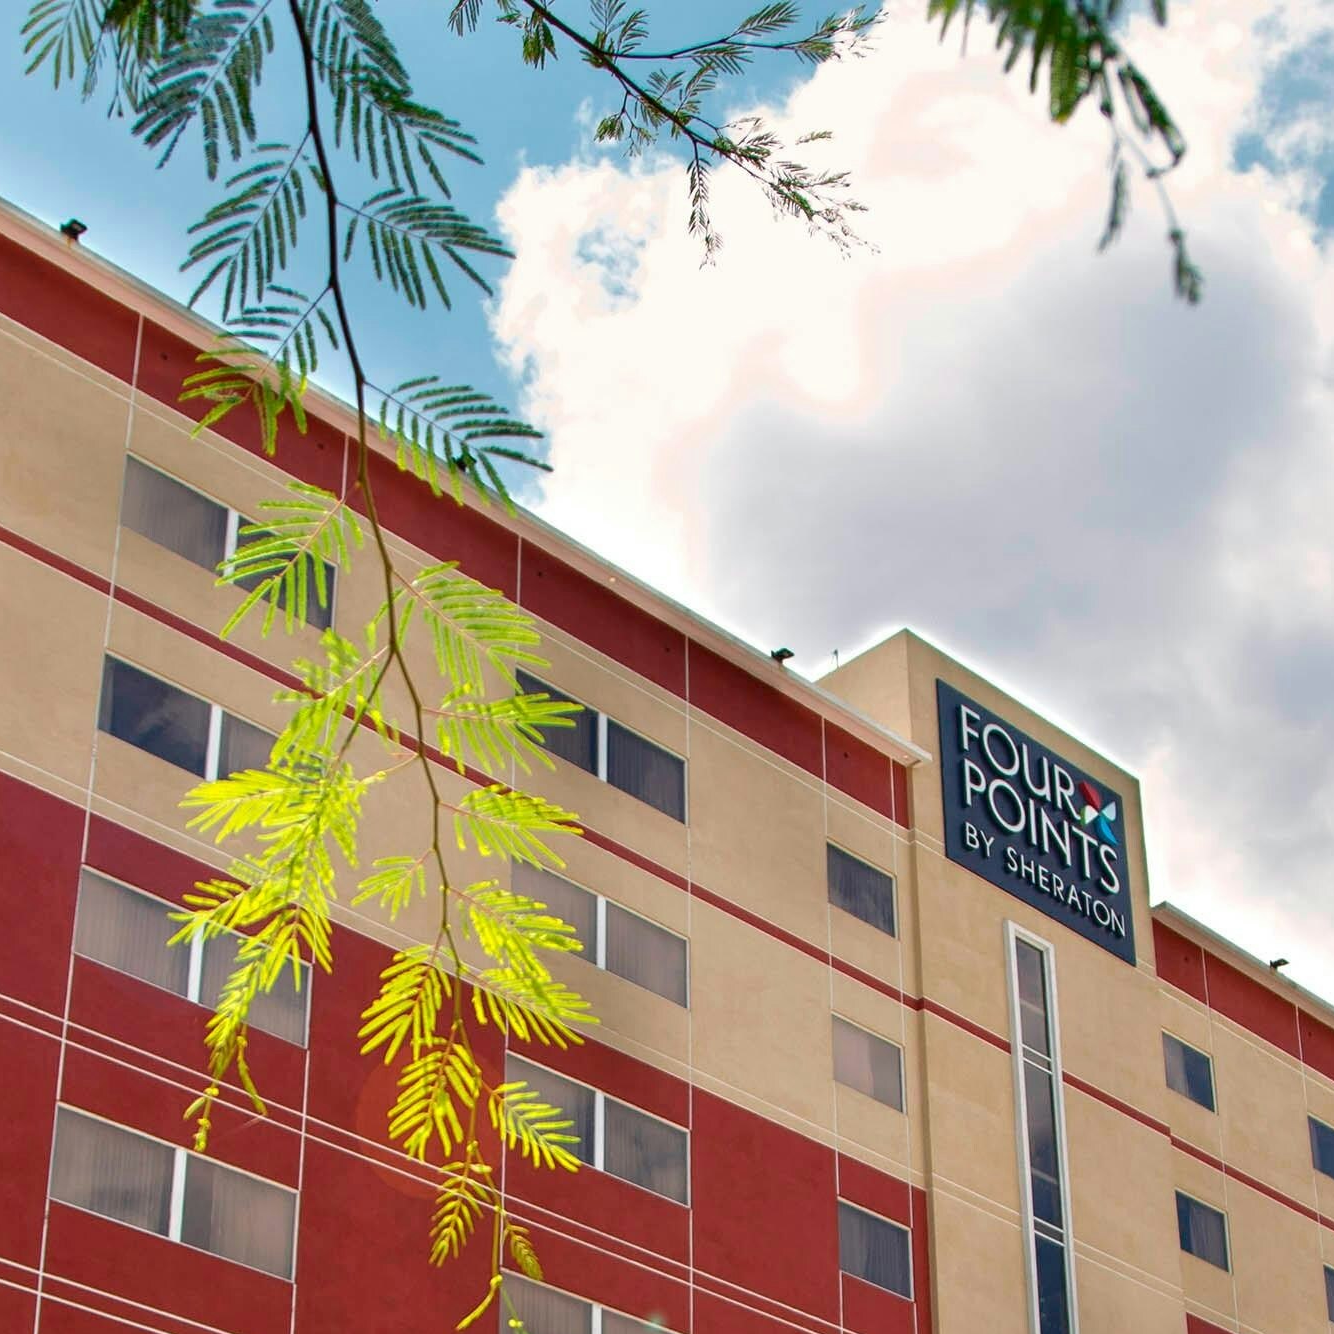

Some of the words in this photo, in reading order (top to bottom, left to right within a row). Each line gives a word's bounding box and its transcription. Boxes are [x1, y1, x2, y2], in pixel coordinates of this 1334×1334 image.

[958, 704, 1082, 820] FOUR
[963, 758, 1120, 895] POINTS
[965, 822, 996, 857] BY
[1006, 846, 1126, 938] SHERATON
